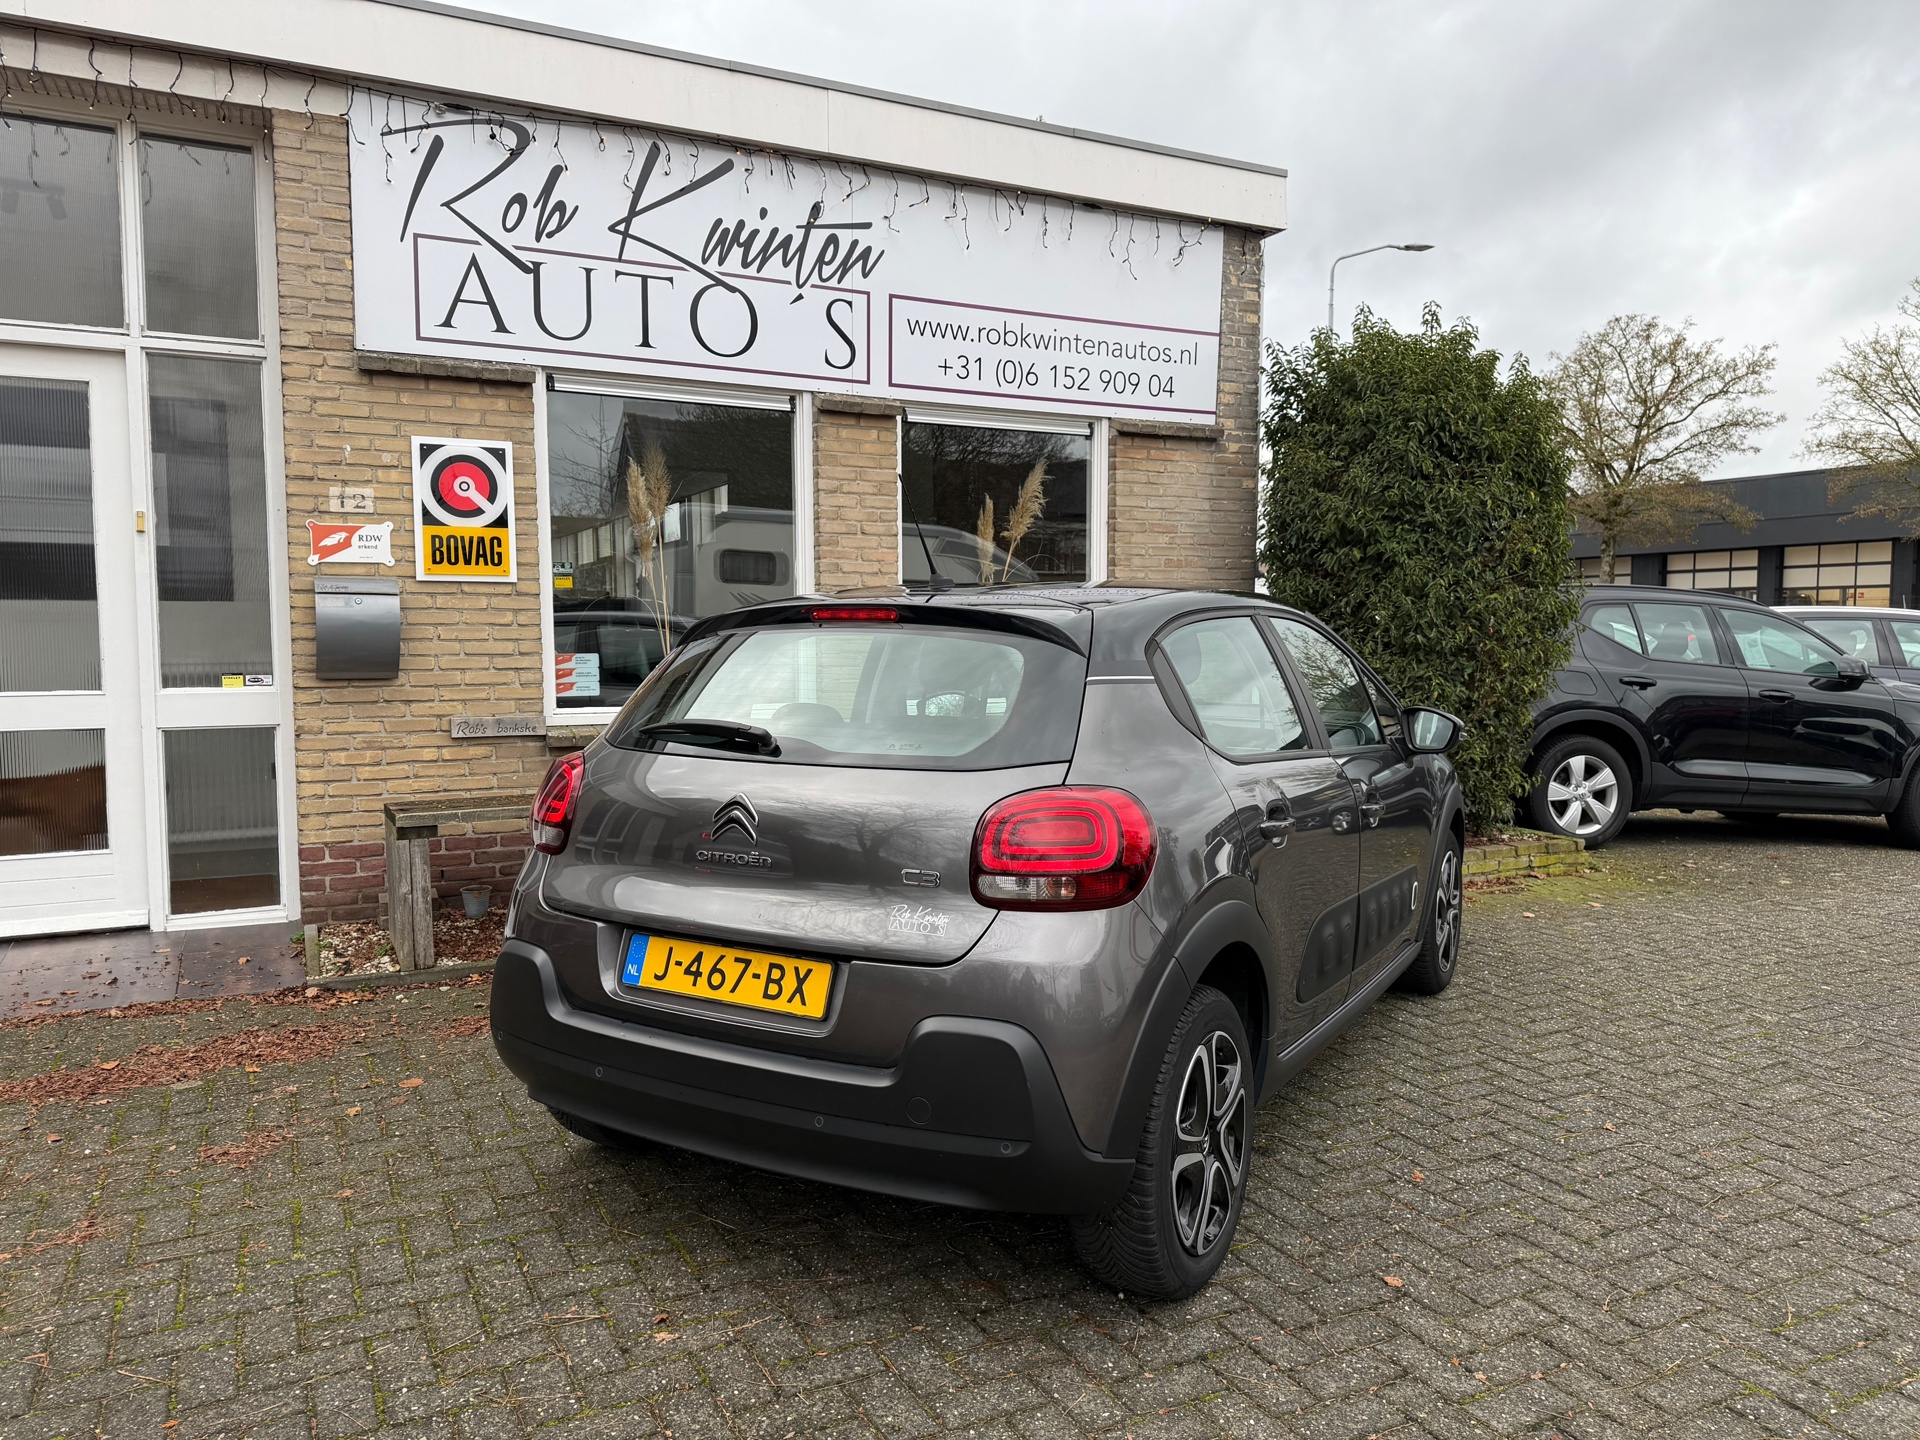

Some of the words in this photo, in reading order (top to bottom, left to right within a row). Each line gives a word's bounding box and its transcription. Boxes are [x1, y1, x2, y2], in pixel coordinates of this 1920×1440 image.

[381, 118, 579, 275] Rob
[608, 141, 885, 293] Kwinten
[906, 318, 1198, 366] www.robkwintenautos.nl
[938, 355, 983, 381] +31
[995, 359, 1039, 390] (0)6
[1050, 364, 1091, 391] 152
[1099, 369, 1141, 396] 909
[1149, 374, 1176, 398] 04
[337, 493, 367, 510] 12
[357, 534, 383, 542] RDW
[430, 534, 503, 567] BOVAG
[456, 721, 488, 736] Rob's
[496, 722, 537, 734] bankske
[695, 850, 772, 868] CITROËN
[901, 868, 941, 888] C3
[890, 904, 911, 923] Rob
[626, 963, 639, 976] NL
[653, 946, 814, 1007] J-467-BX
